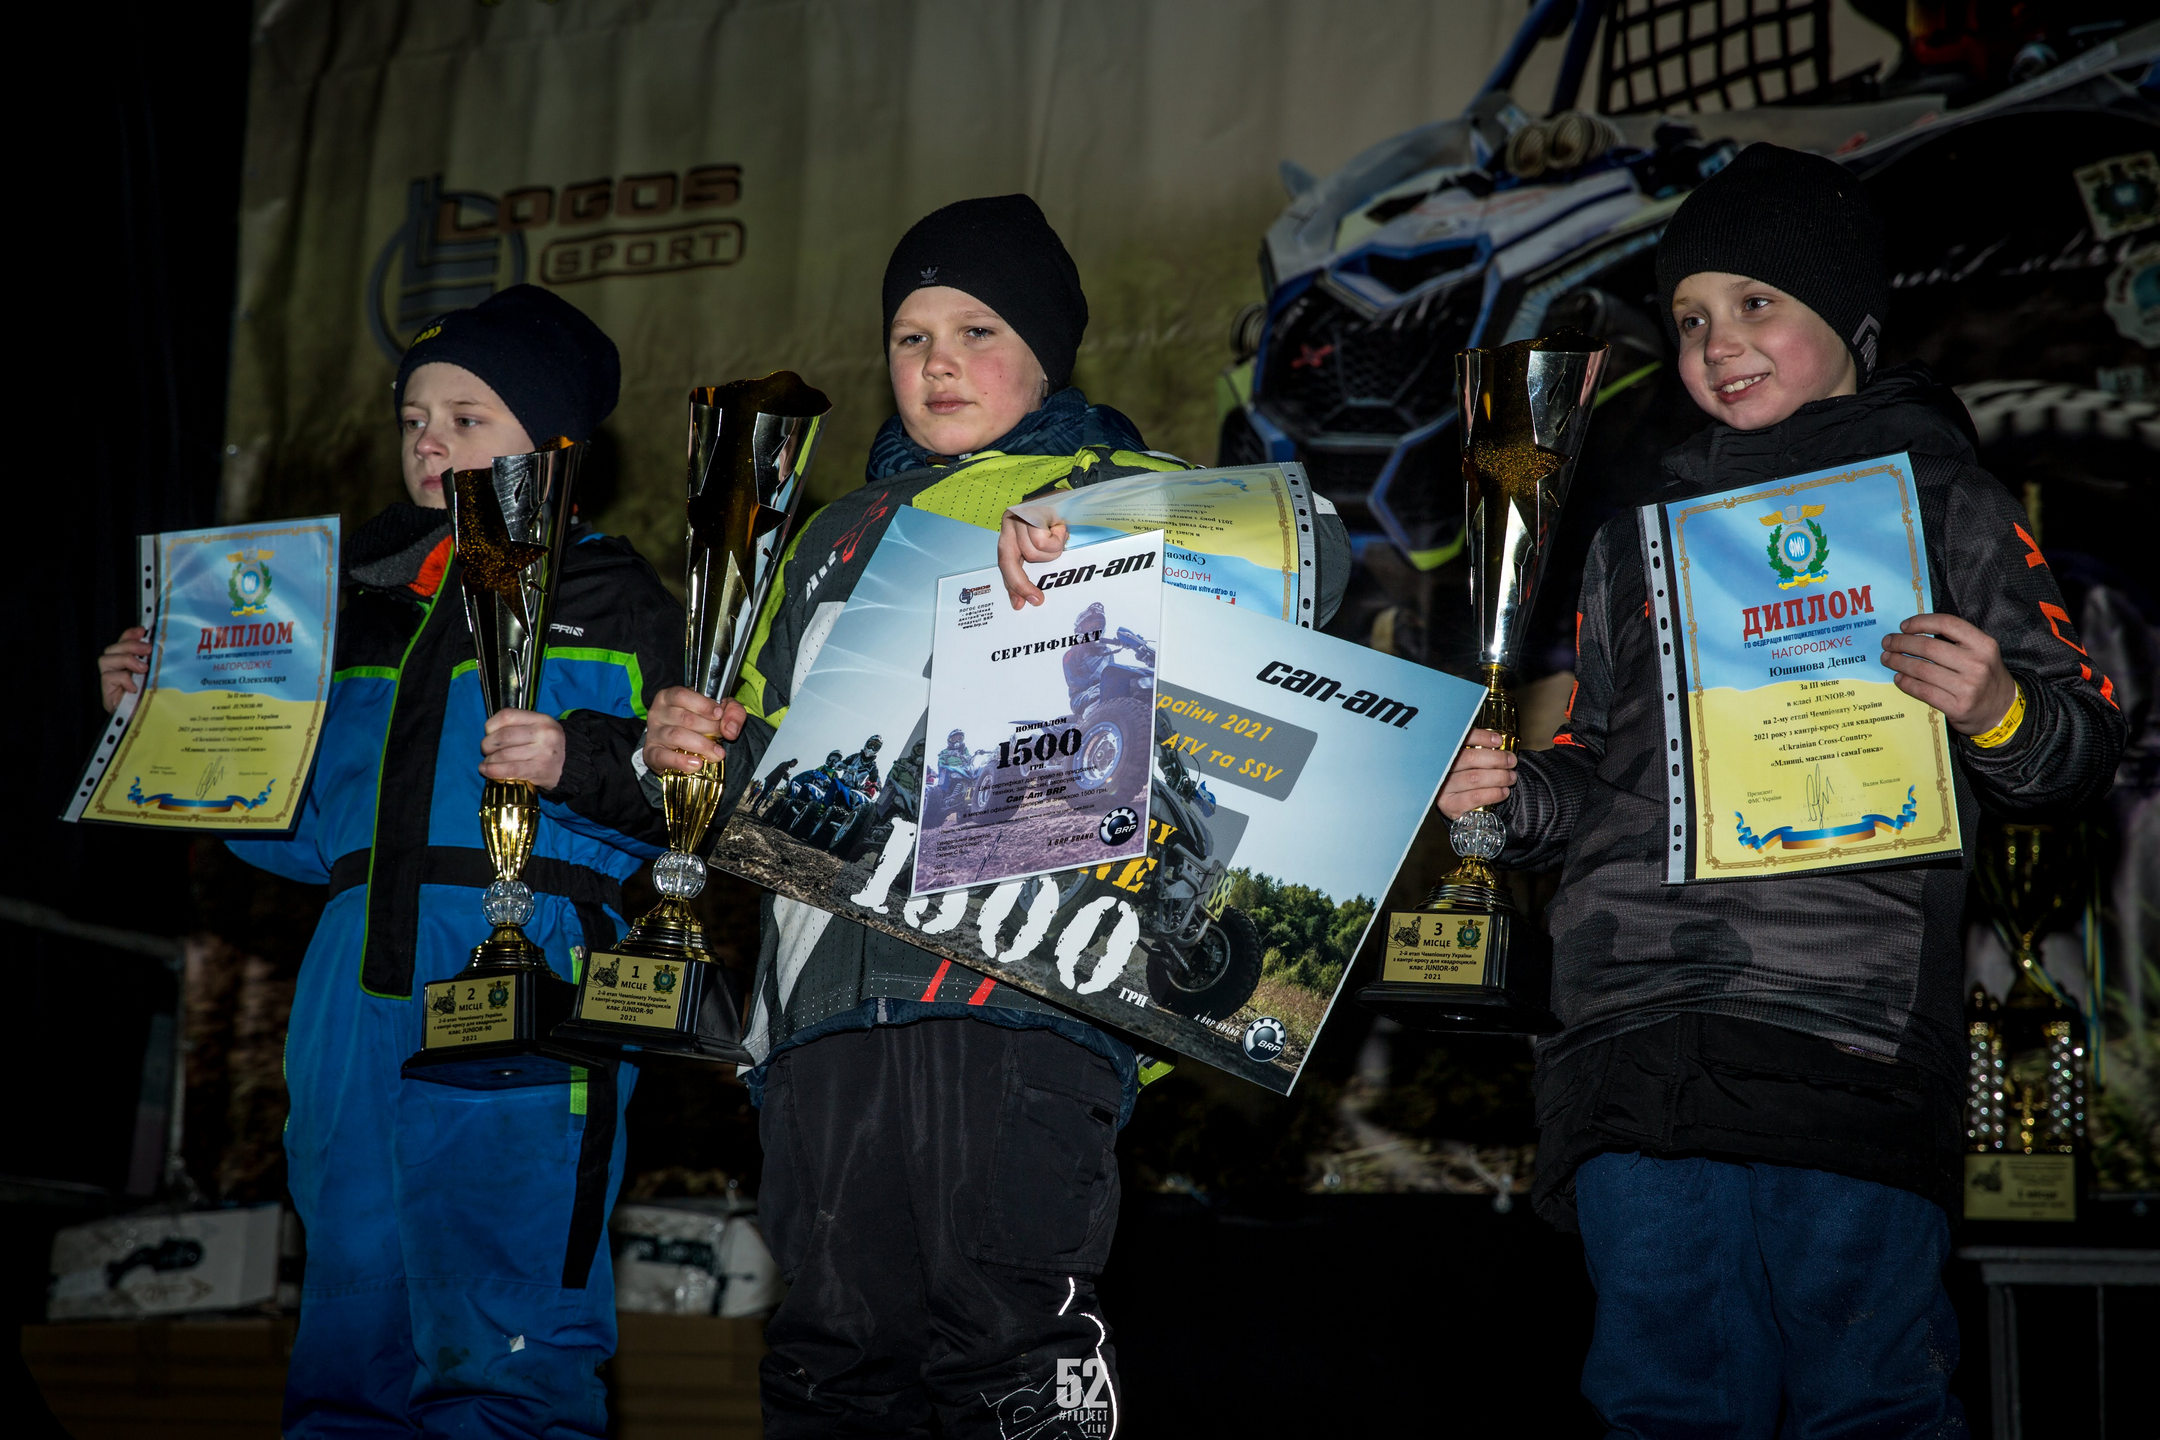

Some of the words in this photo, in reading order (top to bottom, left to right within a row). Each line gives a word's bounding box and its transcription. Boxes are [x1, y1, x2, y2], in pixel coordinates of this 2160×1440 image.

[436, 165, 742, 241] LOGOS
[553, 231, 731, 277] SPORT
[1037, 551, 1156, 591] can-am
[1198, 585, 1228, 595] ФЕДЕРАЦІЯ
[1742, 585, 1874, 641] ДИПЛОМ
[197, 622, 294, 654] ДИПЛОМ
[1752, 637, 1782, 648] ФЕДЕРАЦІЯ
[1783, 628, 1831, 644] МОТОЦИКЛЕТНОГО
[1832, 624, 1852, 633] СПОРТУ
[1854, 618, 1876, 629] УКРАЇНИ
[990, 630, 1103, 663] СЕРТИФІКАТ
[1772, 636, 1853, 660] НАГОРОДЖУЄ
[213, 660, 272, 671] НАГОРОДЖУЄ
[1769, 660, 1824, 677] Юшинова
[1828, 654, 1866, 672] Дениса
[1256, 660, 1418, 729] can-am
[1810, 681, 1818, 689] III
[1820, 679, 1839, 687] місце
[1793, 697, 1812, 706] класі
[1815, 690, 1855, 703] JUNIOR-90
[1773, 716, 1789, 724] 2-му
[1810, 706, 1850, 718] Чемпіонату
[1853, 701, 1882, 712] України
[1015, 717, 1067, 733] НОМІНАЛОМ
[1220, 714, 1274, 741] 2021
[1754, 733, 1769, 741] 2021
[1771, 732, 1787, 740] року
[1794, 723, 1839, 735] кантрі-кросу
[1856, 712, 1905, 726] квадроциклів
[996, 728, 1082, 770] 1500
[1779, 741, 1816, 751] «Ukrainian
[1818, 733, 1872, 746] Cross-Country»
[1161, 733, 1208, 756] ATV
[1209, 749, 1233, 768] та
[1239, 759, 1283, 783] SSV
[1771, 757, 1804, 767] «Млинці,
[1805, 753, 1835, 762] масляна
[1841, 746, 1884, 757] самаГонка»
[1006, 791, 1043, 803] Can-Am
[1046, 786, 1066, 796] BRP
[1071, 833, 1094, 842] BRAND
[1114, 824, 1136, 834] BRP
[1434, 922, 1443, 936] 3
[1423, 940, 1450, 949] МІСЦЕ
[632, 966, 639, 978] 1
[468, 988, 475, 1000] 2
[621, 981, 647, 990] МІСЦЕ
[459, 1003, 483, 1011] МІСЦЕ
[1119, 986, 1148, 1008] ГРН
[621, 1006, 653, 1014] JUNIOR-90
[1194, 1013, 1200, 1021] A
[1201, 1016, 1216, 1029] BRP
[1216, 1022, 1240, 1037] BRAND
[1258, 1040, 1280, 1052] BRP
